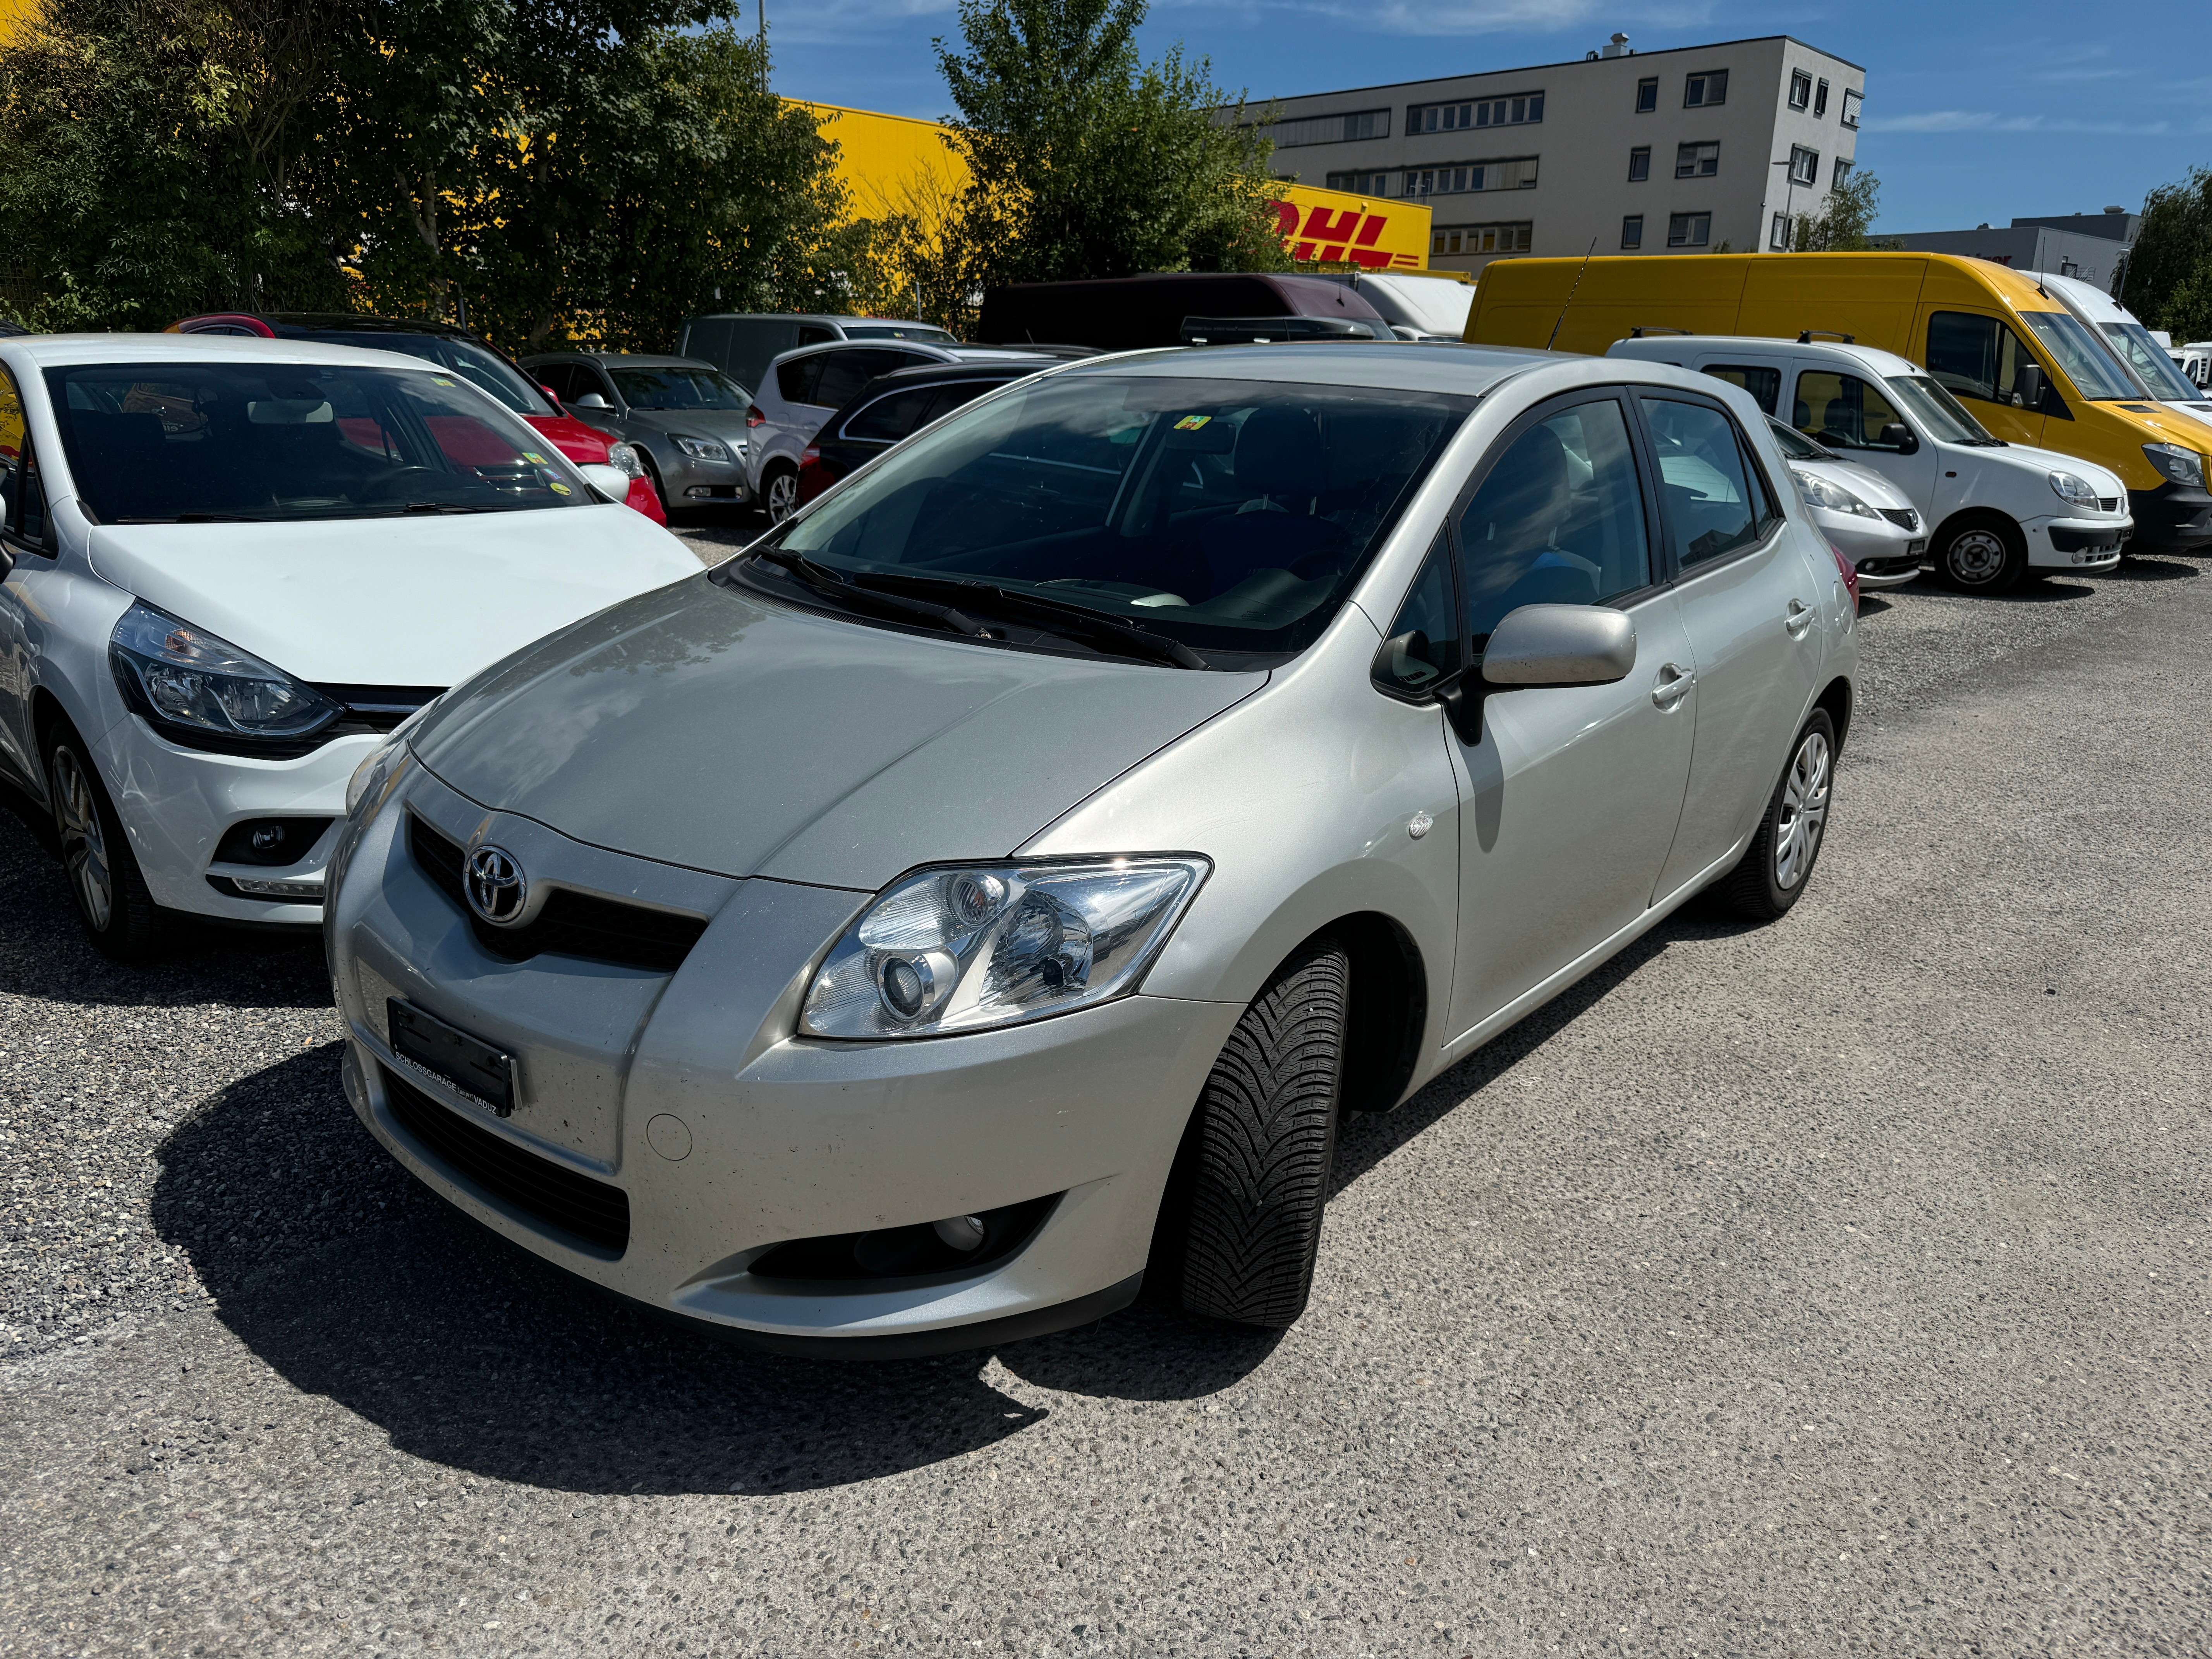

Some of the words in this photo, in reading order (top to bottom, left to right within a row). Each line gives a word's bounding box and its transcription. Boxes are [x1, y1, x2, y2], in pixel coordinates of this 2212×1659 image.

[395, 1051, 457, 1092] SCHLOSSGARAGE
[457, 1087, 474, 1099] Lampert
[474, 1095, 496, 1115] VADUZ
